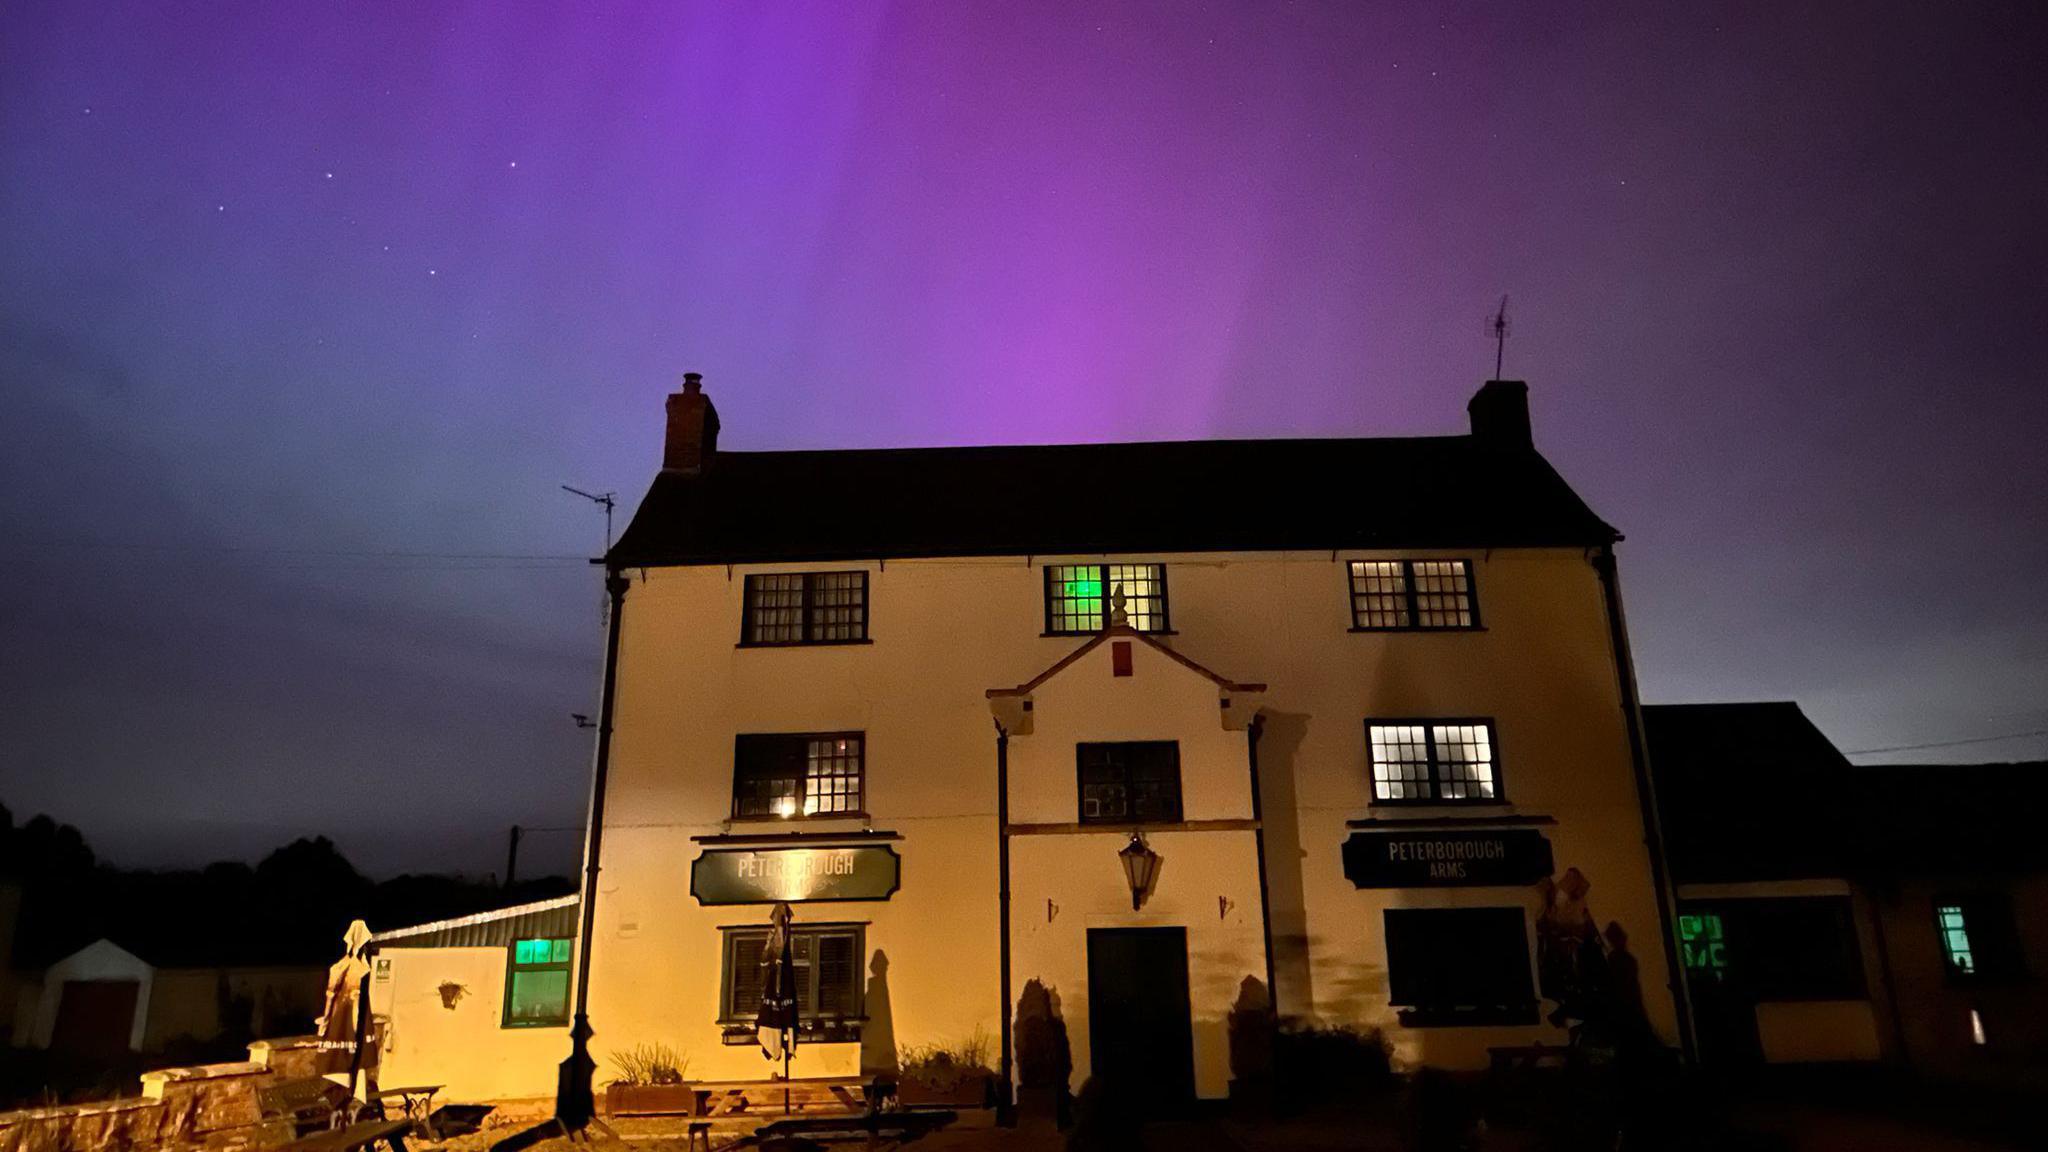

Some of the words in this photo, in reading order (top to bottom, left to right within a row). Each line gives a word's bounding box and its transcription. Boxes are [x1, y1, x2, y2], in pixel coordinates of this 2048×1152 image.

[1389, 840, 1505, 862] PETERBOROUGH
[737, 855, 854, 878] PETERROUGH
[1429, 861, 1467, 879] ARMS
